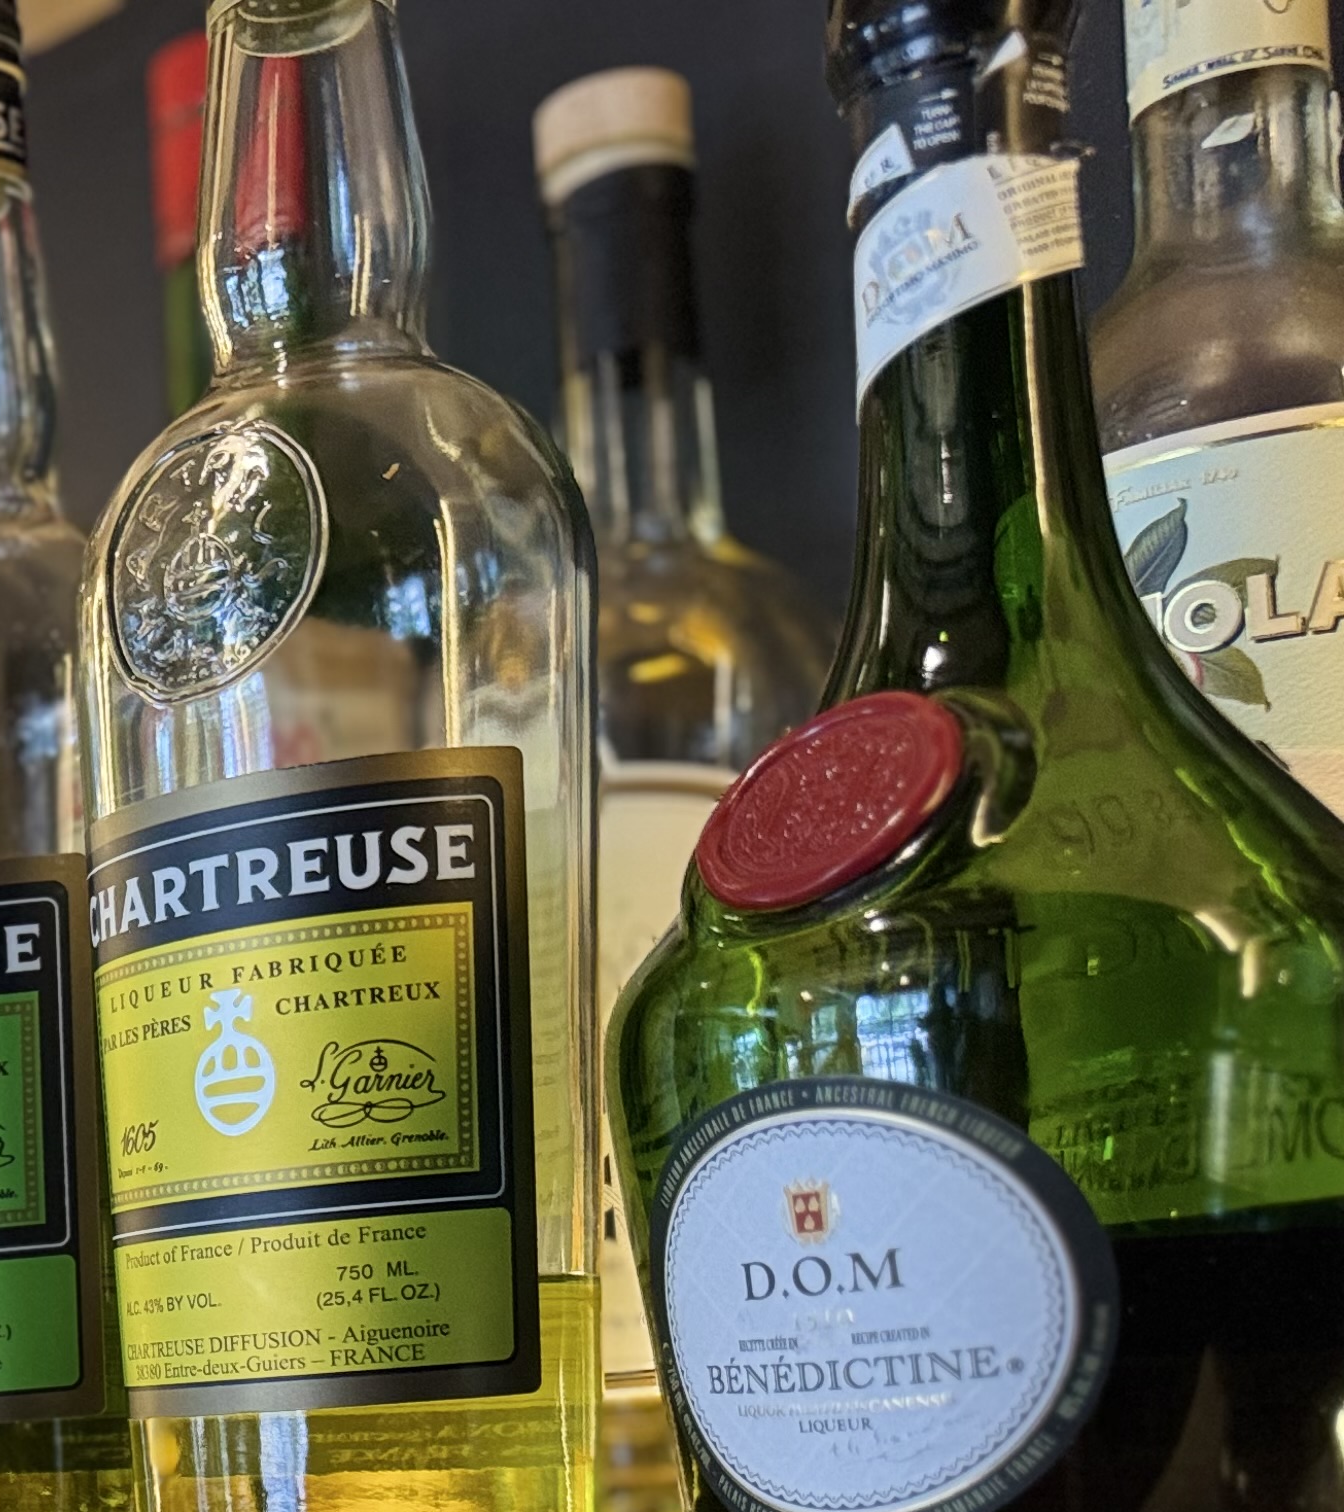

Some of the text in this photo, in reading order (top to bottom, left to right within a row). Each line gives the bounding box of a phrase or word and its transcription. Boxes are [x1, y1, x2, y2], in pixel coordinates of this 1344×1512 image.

[89, 823, 476, 949] CHARTREUSE
[109, 941, 408, 1014] LIQUEUR FABRIQUÉE
[118, 1026, 140, 1047] LES
[141, 1014, 192, 1041] PÈRES
[274, 980, 442, 1016] CHARTREUX
[326, 1041, 447, 1103] Garnier
[748, 1088, 795, 1118] FRANCE
[815, 1084, 894, 1109] ANCESTRAL
[120, 1119, 160, 1158] 1605
[124, 1251, 160, 1270] Product
[162, 1247, 178, 1264] of
[180, 1240, 233, 1262] France
[250, 1231, 321, 1255] Produit
[326, 1227, 352, 1247] de
[358, 1223, 428, 1243] France
[336, 1260, 420, 1281] 750 ML.
[740, 1247, 906, 1302] D.O.M
[143, 1298, 164, 1314] 43%
[166, 1296, 184, 1312] BY
[185, 1292, 222, 1310] VOL.
[316, 1282, 442, 1311] (25,4 FL. OZ.)
[126, 1337, 205, 1362] CHARTREUSE
[209, 1327, 322, 1354] DIFFUSION
[342, 1319, 451, 1347] Aiguenoire
[850, 1325, 932, 1346] RECIPE CREATED IN
[164, 1353, 306, 1380] Entre-deux-Guiers
[329, 1344, 426, 1368] FRANCE
[798, 1417, 874, 1435] LIQUEUR
